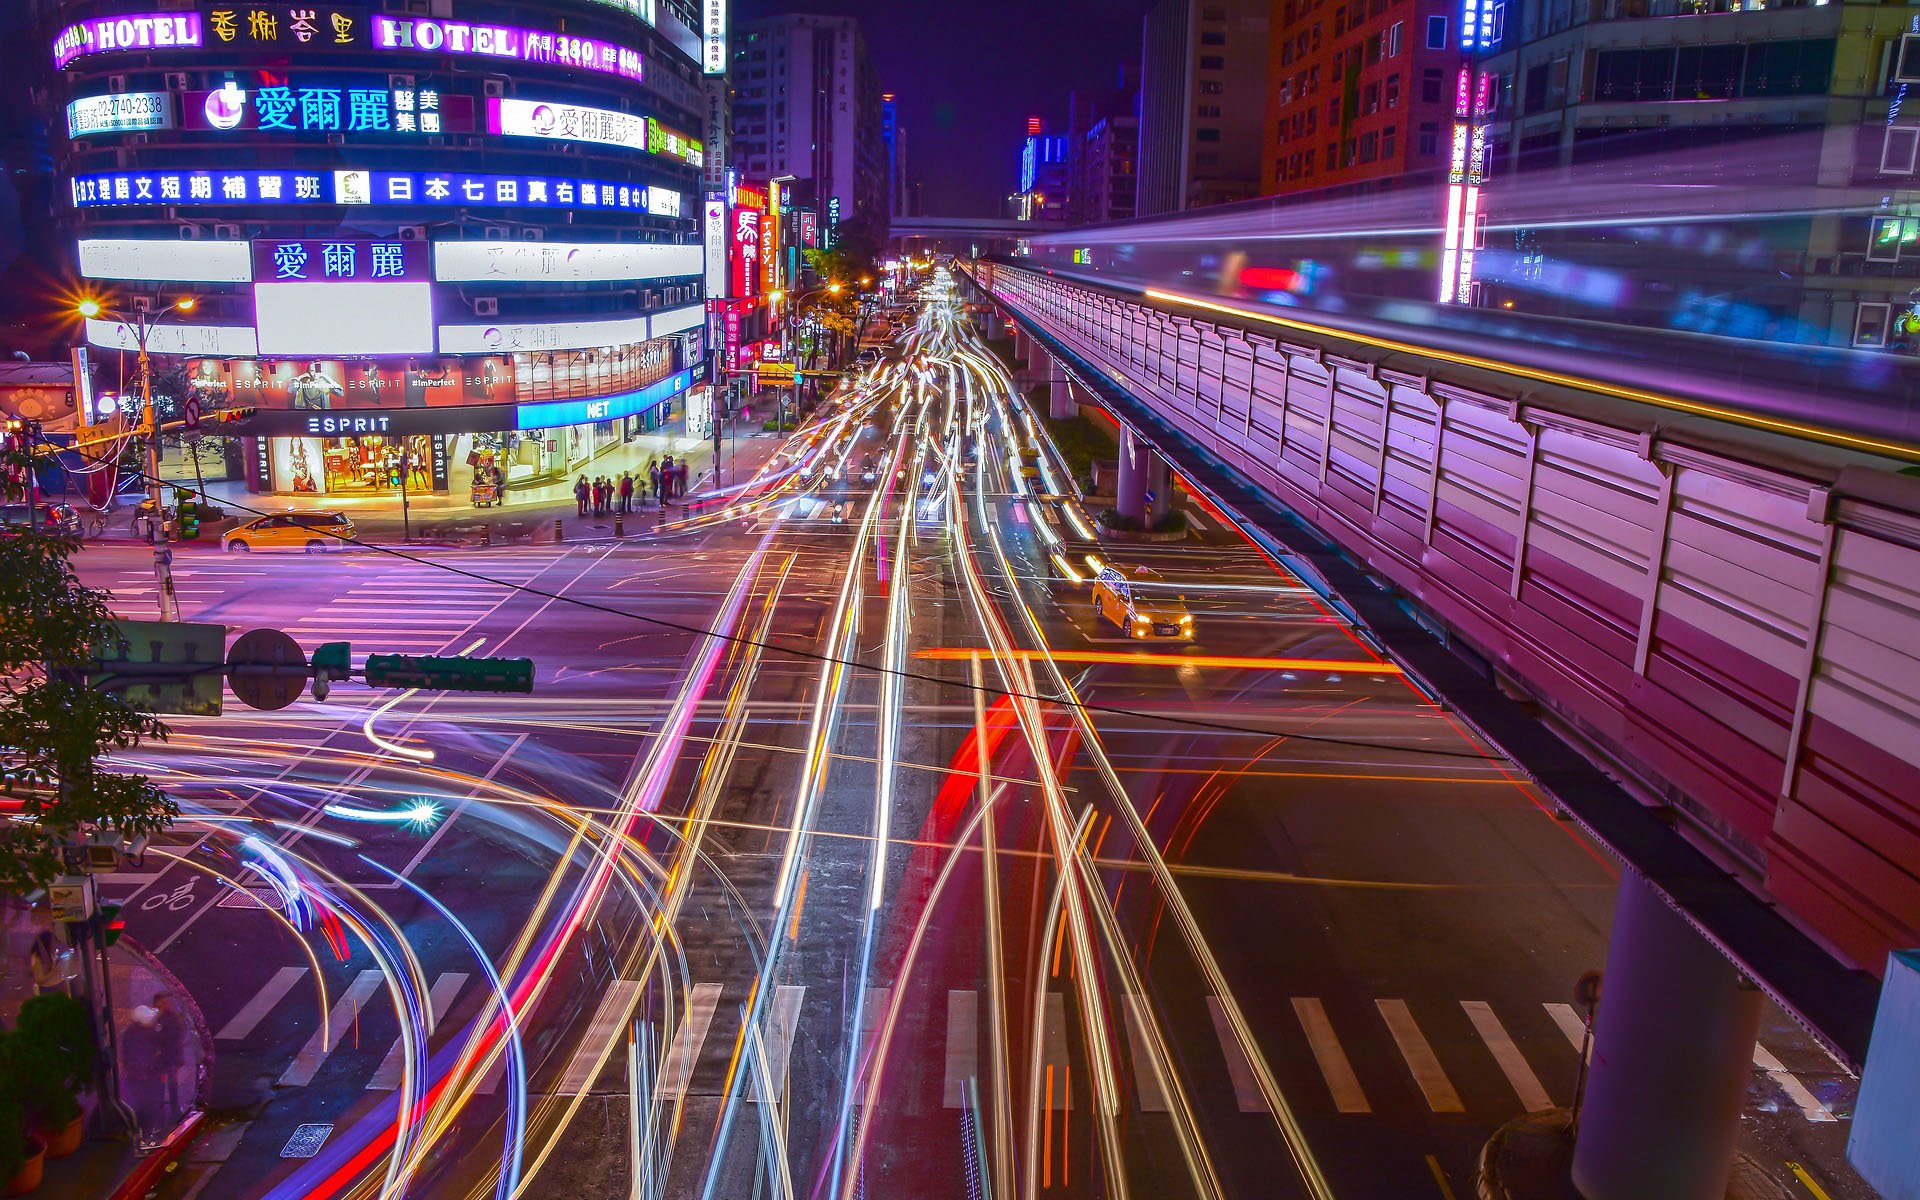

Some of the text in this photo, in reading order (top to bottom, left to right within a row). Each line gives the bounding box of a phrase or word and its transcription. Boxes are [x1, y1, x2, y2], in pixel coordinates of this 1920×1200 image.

[97, 17, 197, 48] HOTEL
[381, 19, 517, 57] HOTEL
[98, 97, 163, 117] 02-2740-2338
[255, 87, 390, 130] 愛爾麗
[394, 90, 439, 112] 醫美
[395, 113, 440, 133] 集團
[762, 221, 772, 265] TASTY
[274, 243, 405, 279] 愛爾麗
[236, 380, 283, 389] ESPRIT
[349, 379, 400, 389] ESPRIT
[412, 378, 456, 388] #ImPerfect
[466, 374, 512, 385] ESPRIT
[587, 402, 609, 419] NET
[309, 417, 389, 432] ESPRIT
[258, 436, 268, 480] ESPRIT
[434, 434, 444, 479] ESPRIT
